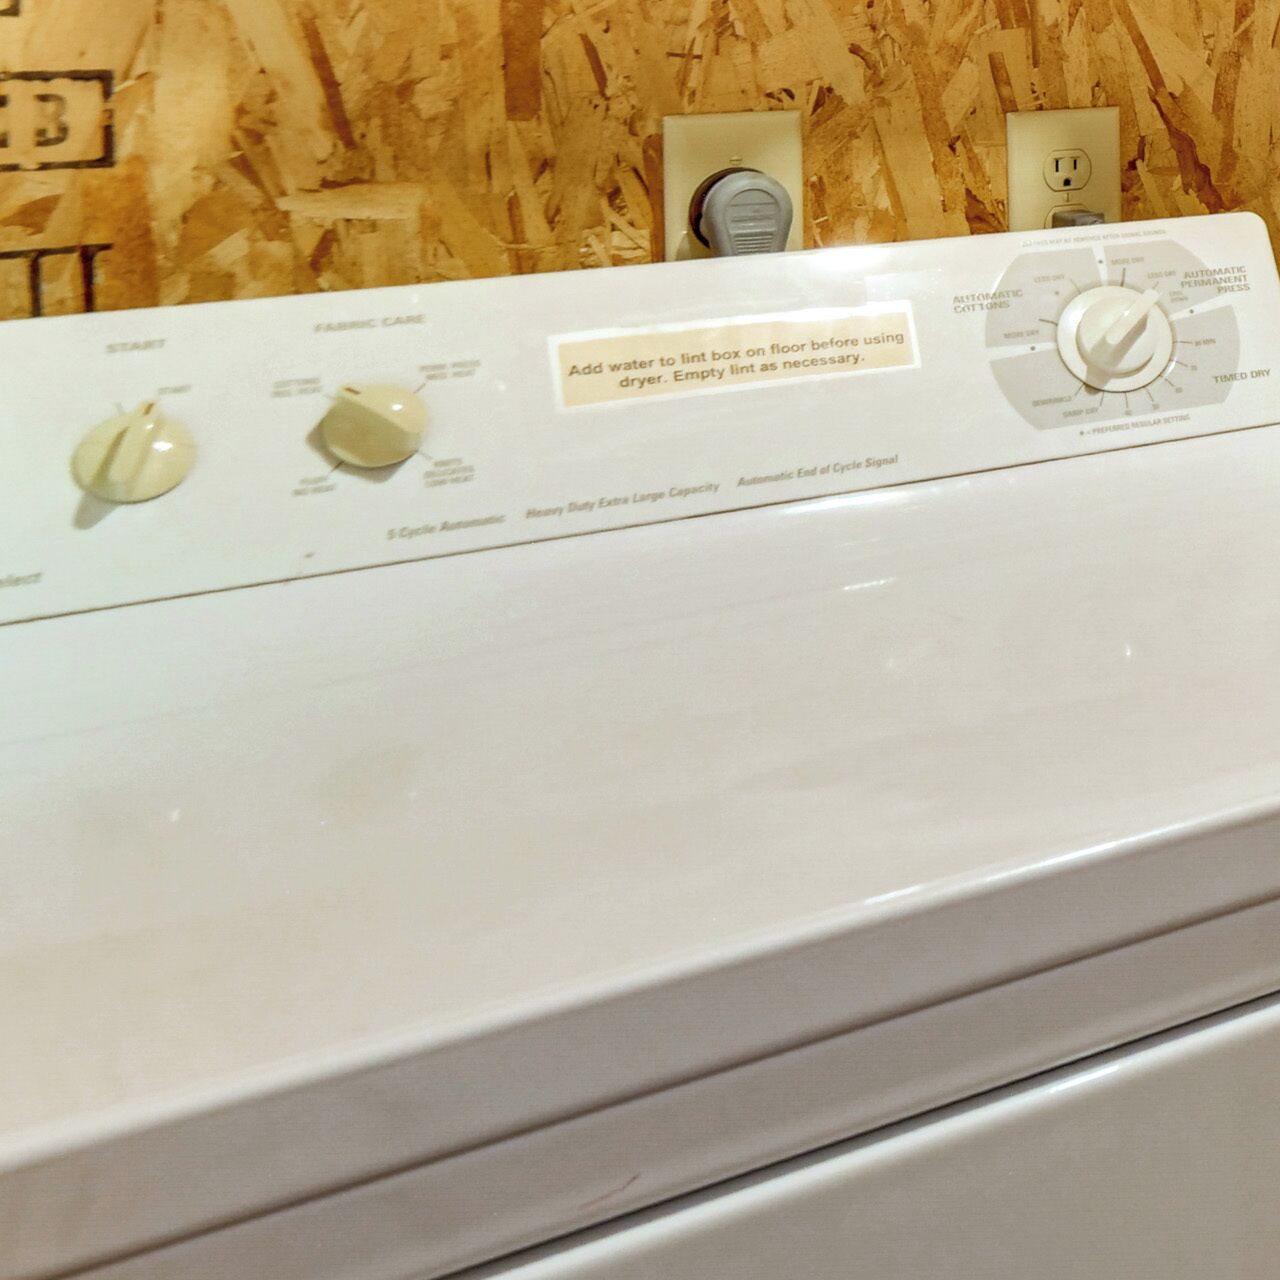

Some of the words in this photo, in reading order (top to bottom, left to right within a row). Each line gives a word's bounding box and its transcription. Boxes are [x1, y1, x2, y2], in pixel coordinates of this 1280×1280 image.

[1183, 265, 1248, 280] AUTOMATIC
[1180, 274, 1249, 289] PERMANENT
[1216, 283, 1252, 295] PRESS
[952, 289, 1024, 306] AUTOMATIC
[953, 300, 1011, 314] COTTONS
[568, 362, 602, 377] Add
[609, 359, 653, 373] water
[660, 356, 676, 368] to
[681, 350, 708, 366] lint
[712, 346, 740, 362] box
[746, 347, 766, 359] on
[770, 339, 807, 356] floor
[811, 335, 860, 353] before
[863, 331, 905, 347] using
[618, 372, 668, 391] dryer.
[674, 365, 725, 385] Empty
[730, 360, 756, 376] lint
[760, 361, 779, 373] as
[783, 351, 866, 372] necessary.
[1213, 371, 1248, 385] TIMED
[1250, 368, 1272, 380] DRY
[737, 470, 794, 488] Automatic
[797, 466, 817, 479] End
[819, 463, 832, 476] of
[833, 459, 864, 475] Cycle
[865, 453, 899, 469] Signal
[526, 506, 564, 520] Heavy
[567, 499, 597, 514] Duty
[598, 494, 631, 509] Extra
[633, 490, 665, 504] Large
[668, 482, 720, 499] Capacity
